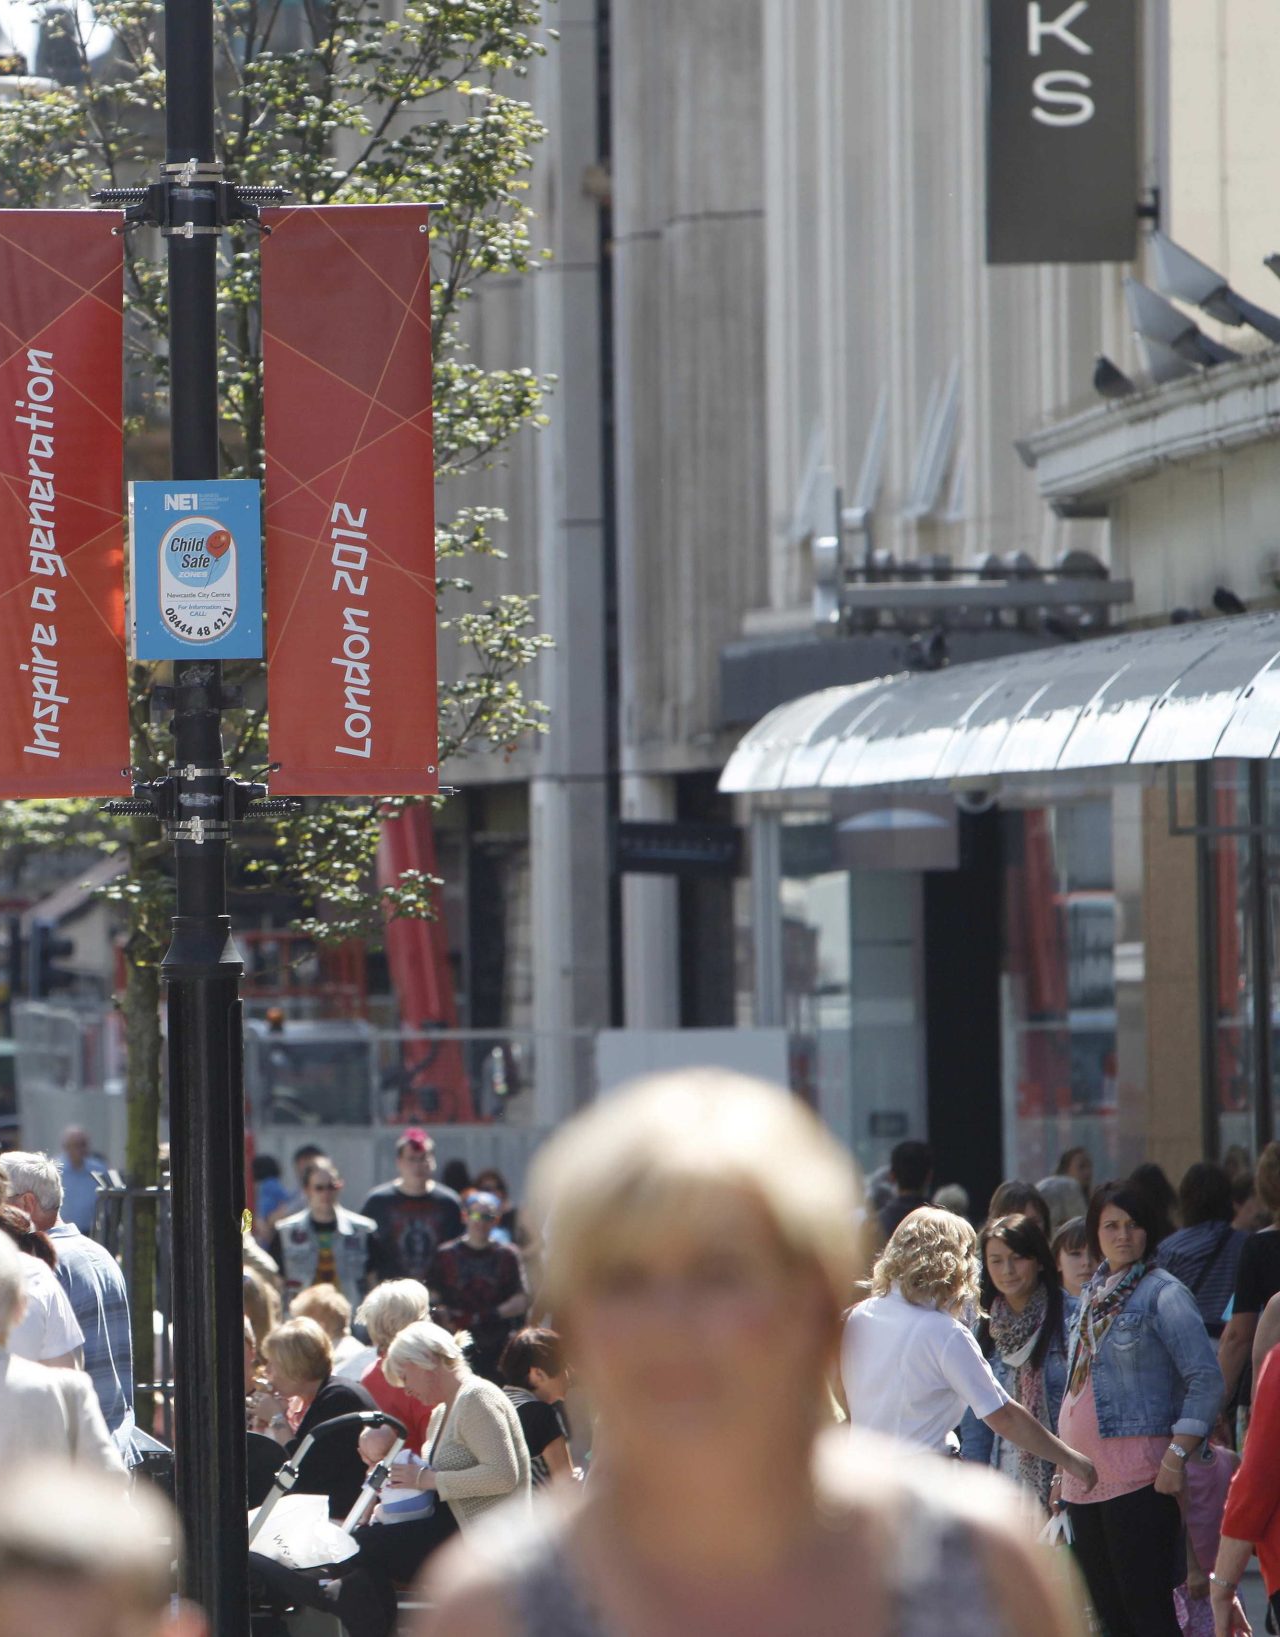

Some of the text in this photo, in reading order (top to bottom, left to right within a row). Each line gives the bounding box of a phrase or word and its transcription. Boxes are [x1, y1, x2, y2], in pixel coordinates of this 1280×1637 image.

[164, 493, 198, 511] NE1
[15, 347, 69, 758] Inspire a generation
[170, 537, 205, 552] Child
[181, 554, 210, 568] Safe
[165, 607, 193, 636] 08444
[196, 626, 211, 636] 48
[213, 618, 227, 631] 42
[222, 607, 233, 619] 21
[330, 502, 372, 759] London 2012
